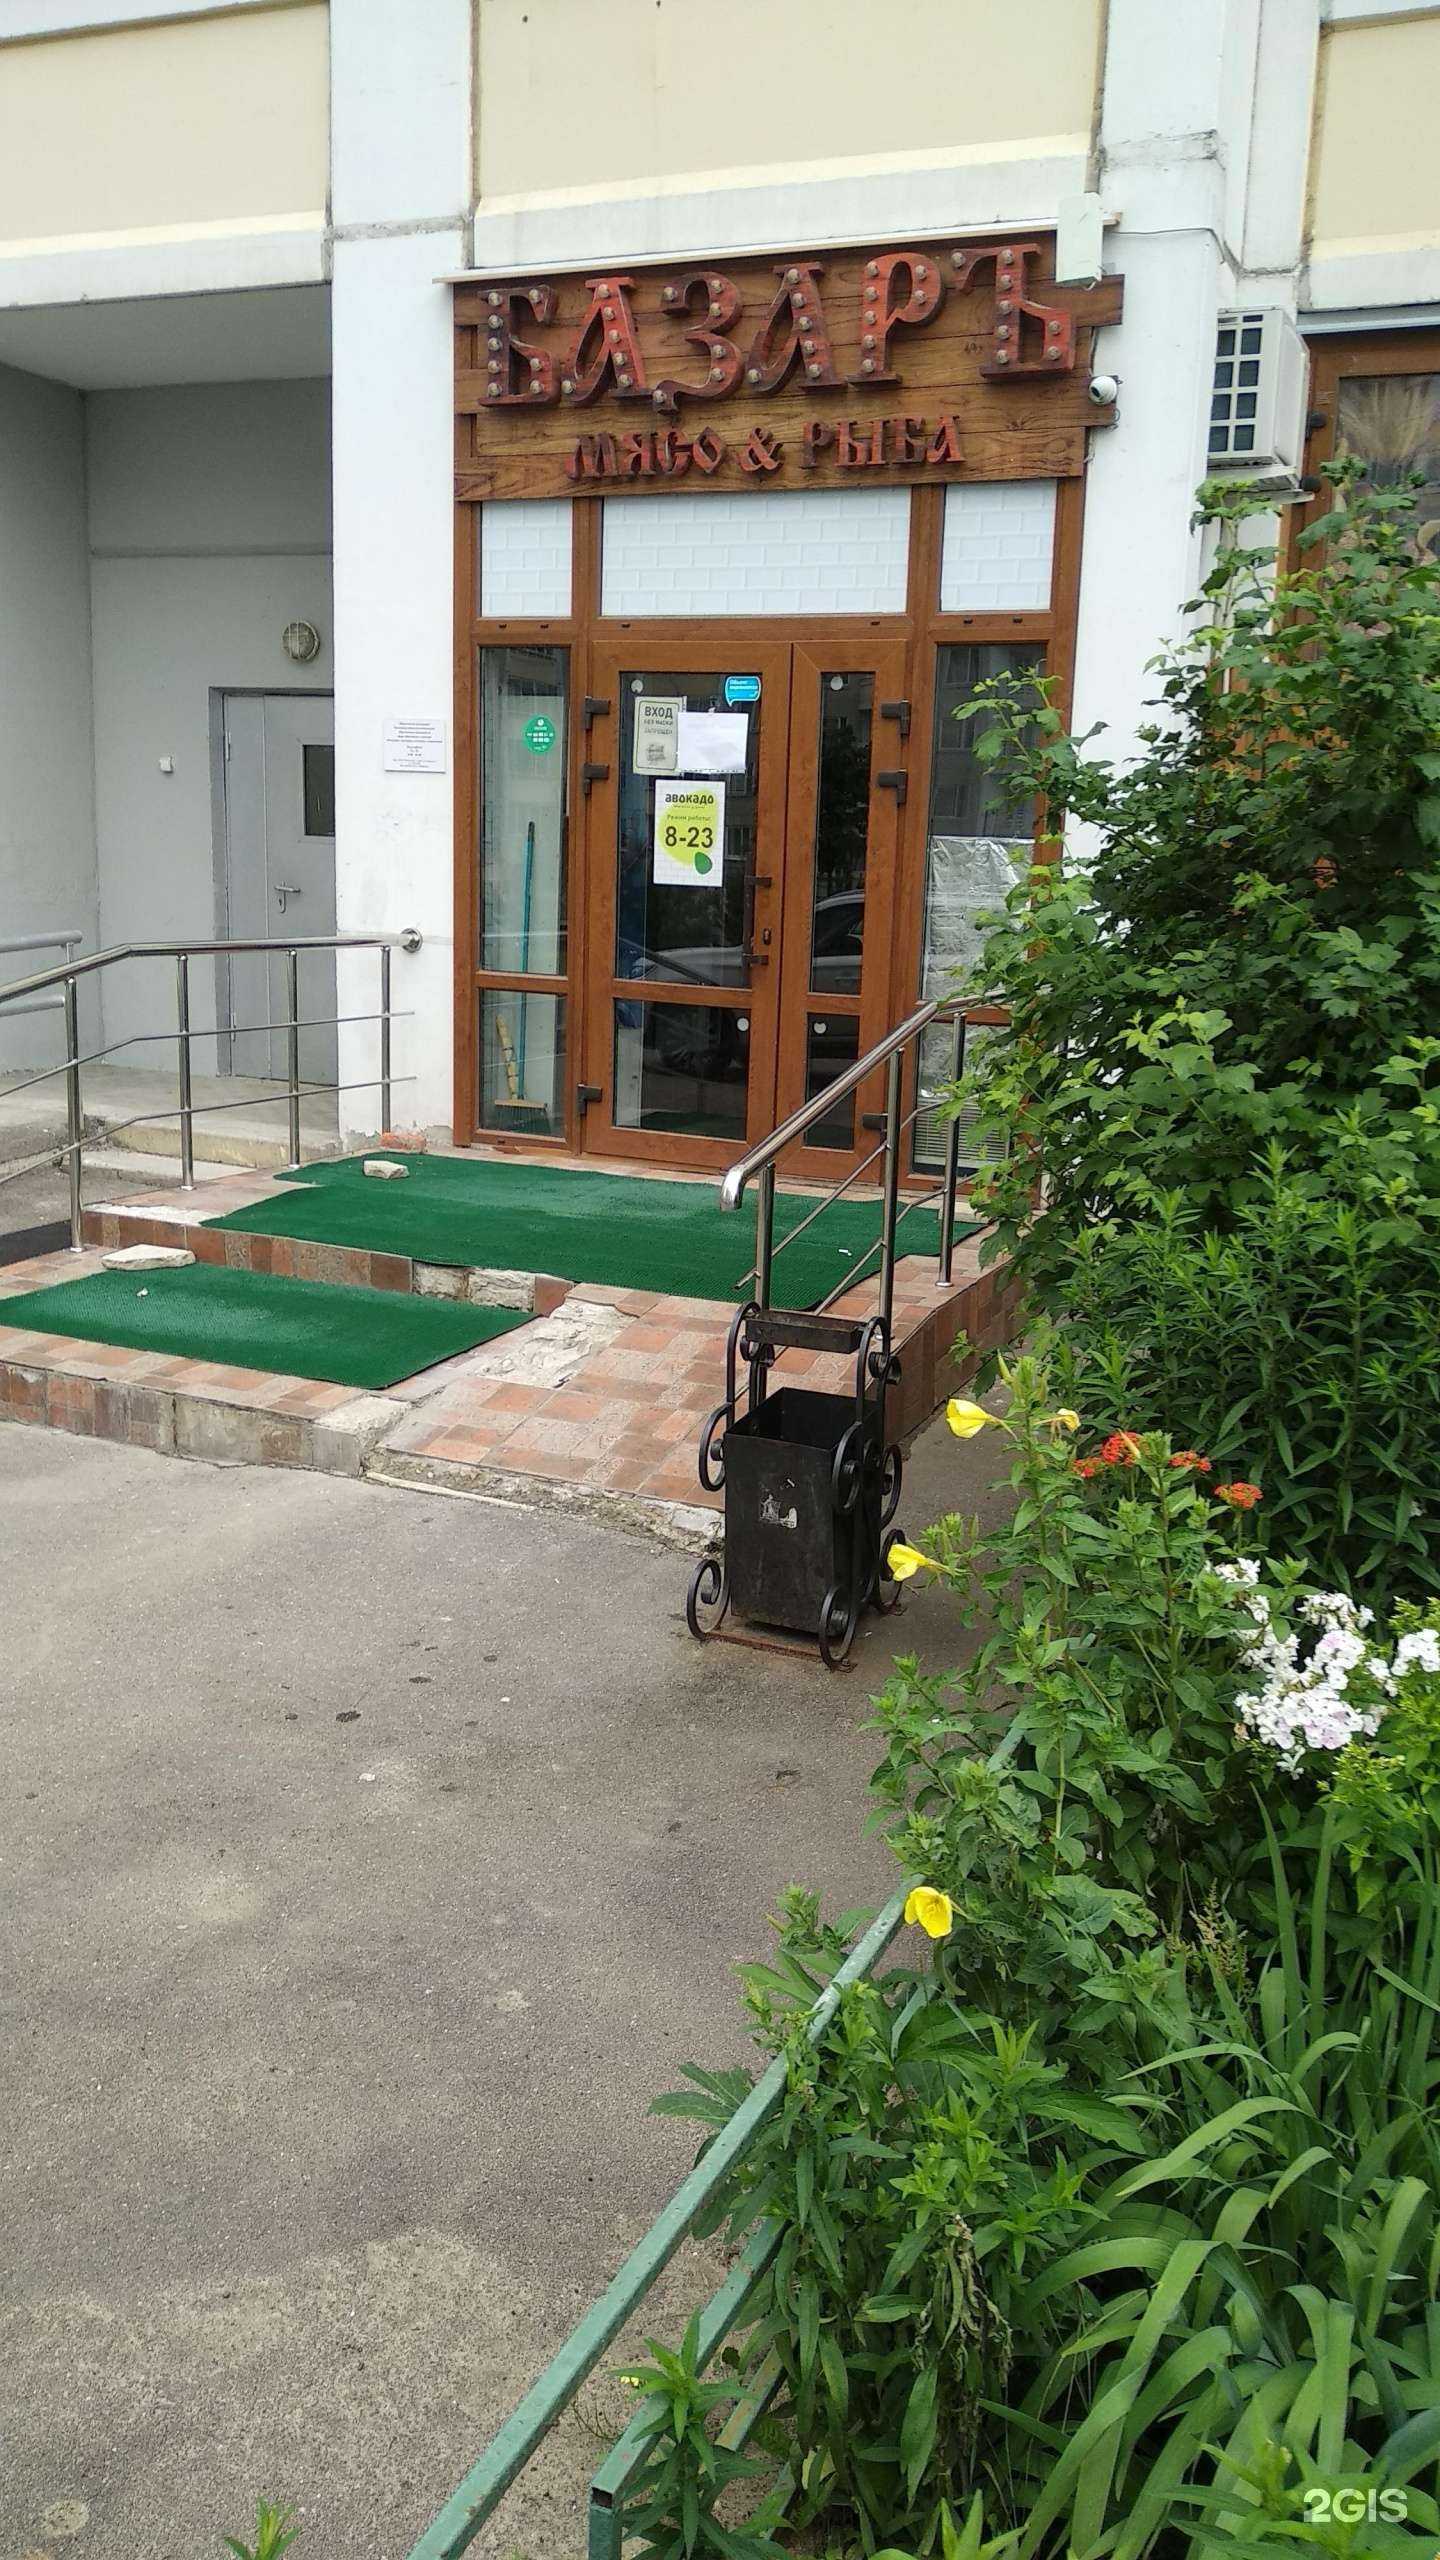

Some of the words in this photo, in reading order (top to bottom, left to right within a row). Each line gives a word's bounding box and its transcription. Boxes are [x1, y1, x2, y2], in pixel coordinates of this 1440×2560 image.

[478, 243, 1077, 414] БАЗАРЪ
[565, 426, 727, 480] МЯСО
[738, 425, 786, 472] &
[801, 414, 966, 469] РЫБА
[644, 705, 673, 719] ВХОД
[665, 793, 714, 805] авокадо
[665, 826, 714, 848] 8-23
